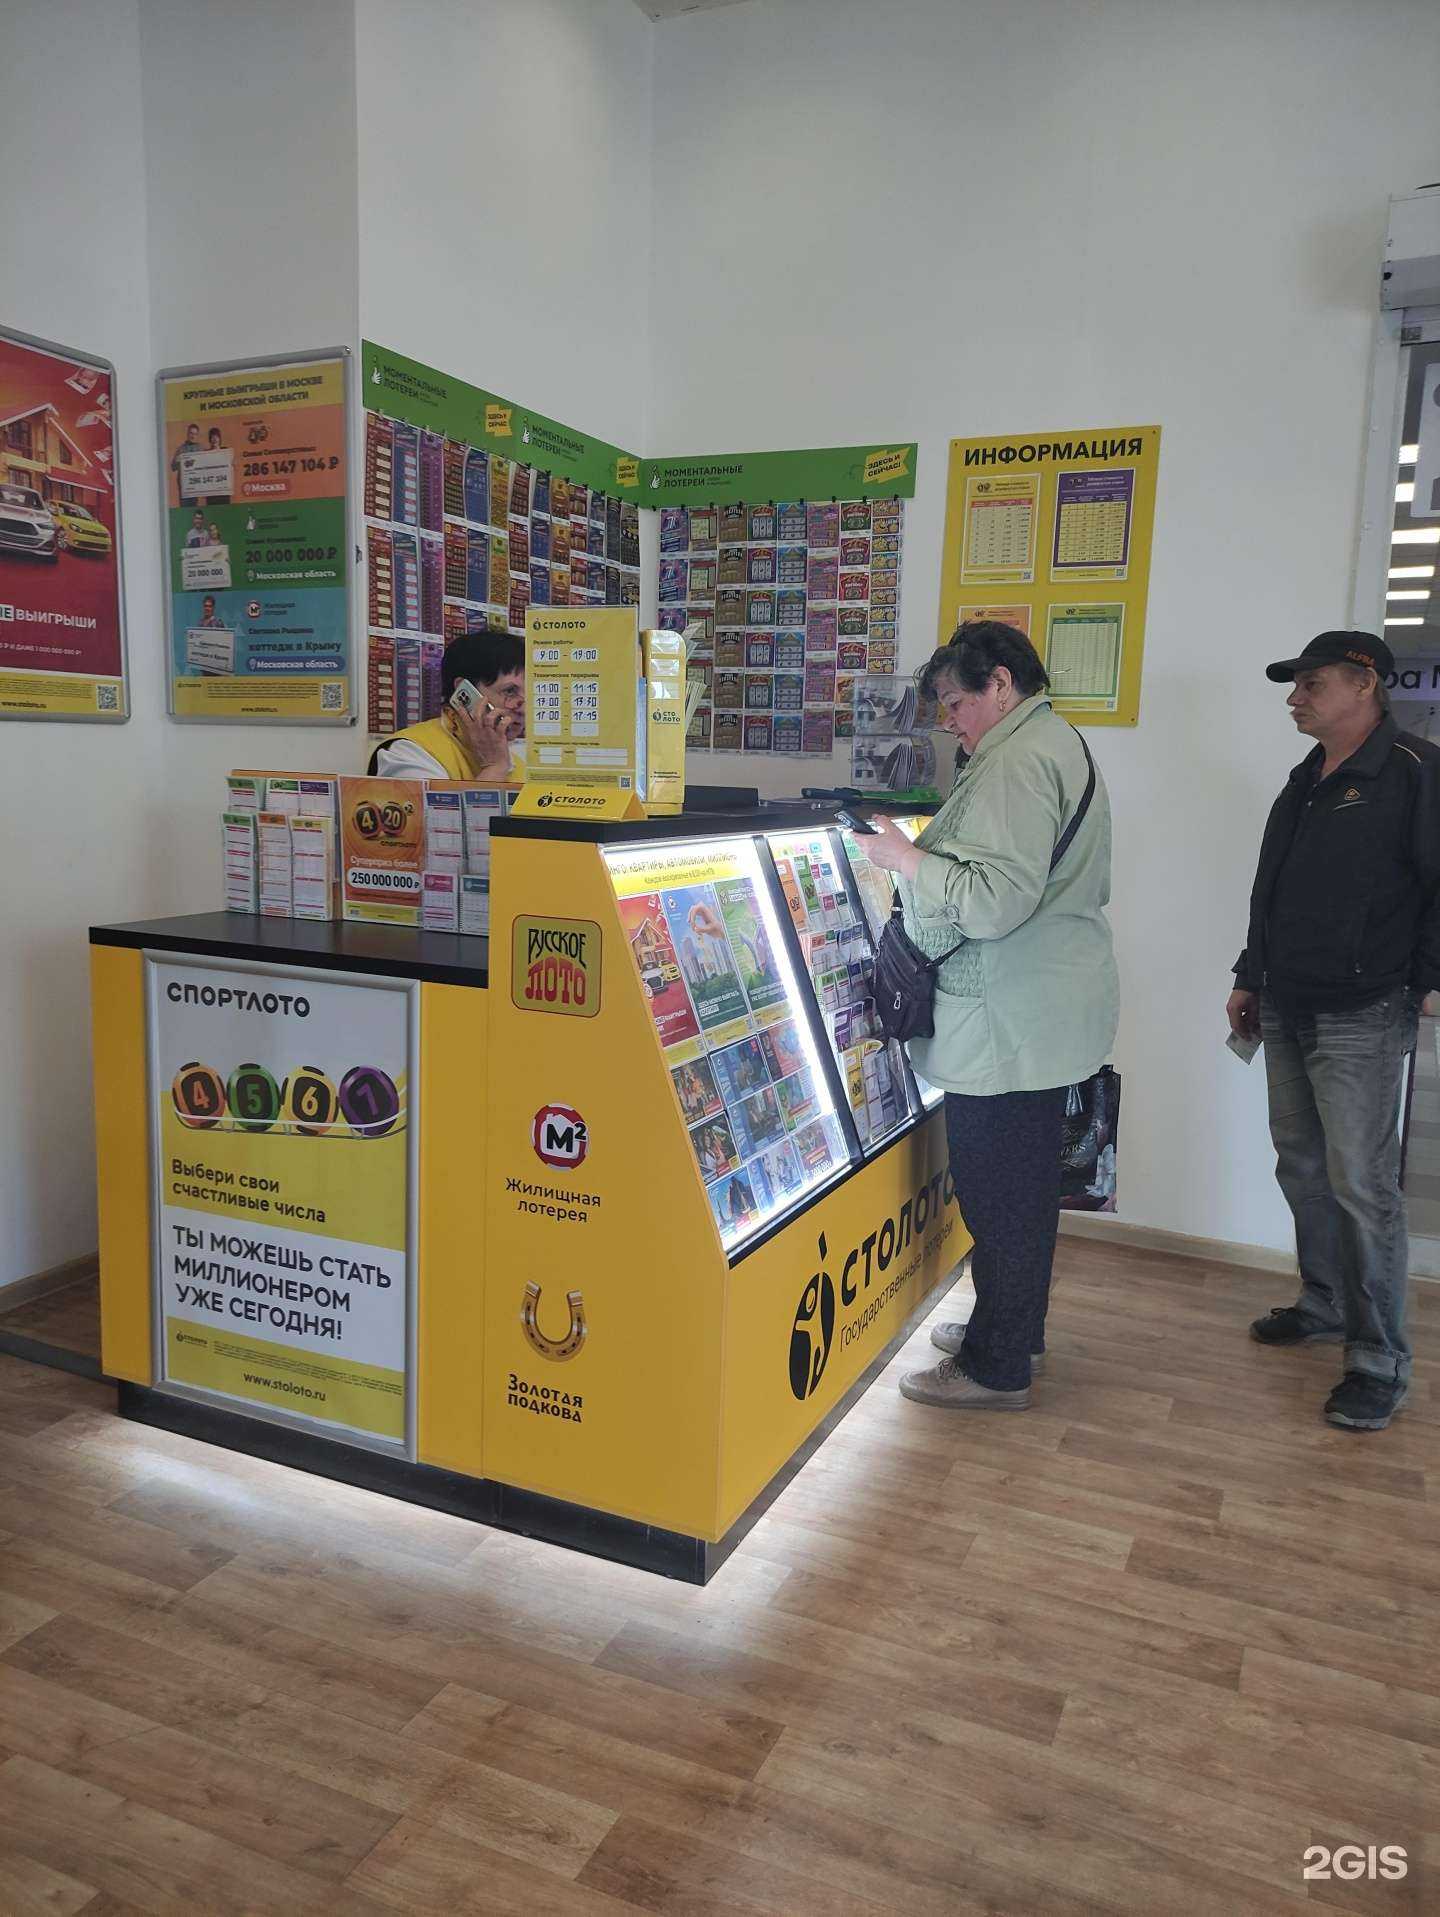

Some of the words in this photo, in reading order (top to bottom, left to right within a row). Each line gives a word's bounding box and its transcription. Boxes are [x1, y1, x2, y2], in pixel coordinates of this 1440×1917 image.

[183, 387, 225, 400] КРУПНЫЕ
[226, 381, 279, 395] ВЫИГРЫШИ
[286, 375, 323, 388] МОСКВЕ
[383, 365, 448, 399] МОМЕНТАЛЬНЫЕ
[383, 378, 419, 398] ЛОТЕРЕИ
[200, 402, 208, 411] И
[208, 395, 266, 410] МОСКОВСКОЙ
[268, 390, 309, 404] ОБЛАСТИ
[532, 425, 584, 454] МОМЕНТАЛЬНЫЕ
[532, 437, 560, 456] ЛОТЕРЕИ
[867, 457, 893, 469] ЗДЕСЬ
[964, 437, 1143, 467] ИНФОРМАЦИЯ
[243, 463, 269, 477] 286
[273, 460, 296, 475] 147
[300, 457, 326, 472] 104
[664, 464, 743, 477] МОМЕНТАЛЬНЫЕ
[867, 462, 901, 477] СЕЙЧАС!
[252, 482, 287, 493] Москва
[663, 478, 705, 488] ЛОТЕРЕИ
[246, 550, 262, 563] 20
[266, 549, 293, 562] 000
[297, 548, 324, 561] 000
[256, 571, 303, 580] Московская
[305, 570, 336, 578] область
[16, 608, 96, 629] ВЫИГРЫШИ
[543, 620, 586, 630] СТОЛОТО
[305, 641, 342, 653] Крыму
[257, 661, 303, 669] Московская
[305, 659, 338, 668] область
[554, 795, 606, 806] СТОЛОТО
[361, 810, 374, 830] 4
[383, 809, 400, 827] 20
[352, 872, 371, 884] 250
[372, 874, 392, 887] 000
[393, 876, 413, 889] 000
[528, 928, 587, 968] РУССКОЕ
[524, 956, 587, 1006] ЛОТО
[166, 981, 311, 1018] СПОРТЛОТО
[193, 1080, 210, 1109] 4
[246, 1083, 261, 1114] 5
[301, 1086, 319, 1117] 6
[357, 1083, 379, 1116] 7
[172, 1158, 235, 1186] Выбери
[239, 1174, 280, 1194] свои
[172, 1181, 270, 1212] счастливые
[274, 1204, 326, 1223] числа
[505, 1177, 601, 1208] Жилищная
[517, 1199, 588, 1223] лотерея
[841, 1166, 956, 1307] СТОЛОТО
[172, 1224, 204, 1250] ТЫ
[210, 1232, 313, 1273] МОЖЕШЬ
[319, 1256, 392, 1289] СТАТЬ
[174, 1255, 351, 1312] МИЛЛИОНЕРОМ
[175, 1284, 224, 1314] УЖЕ
[229, 1297, 342, 1340] СЕГОДНЯ!
[840, 1254, 922, 1353] Государственные
[243, 1372, 327, 1402] www.stoloto.ru
